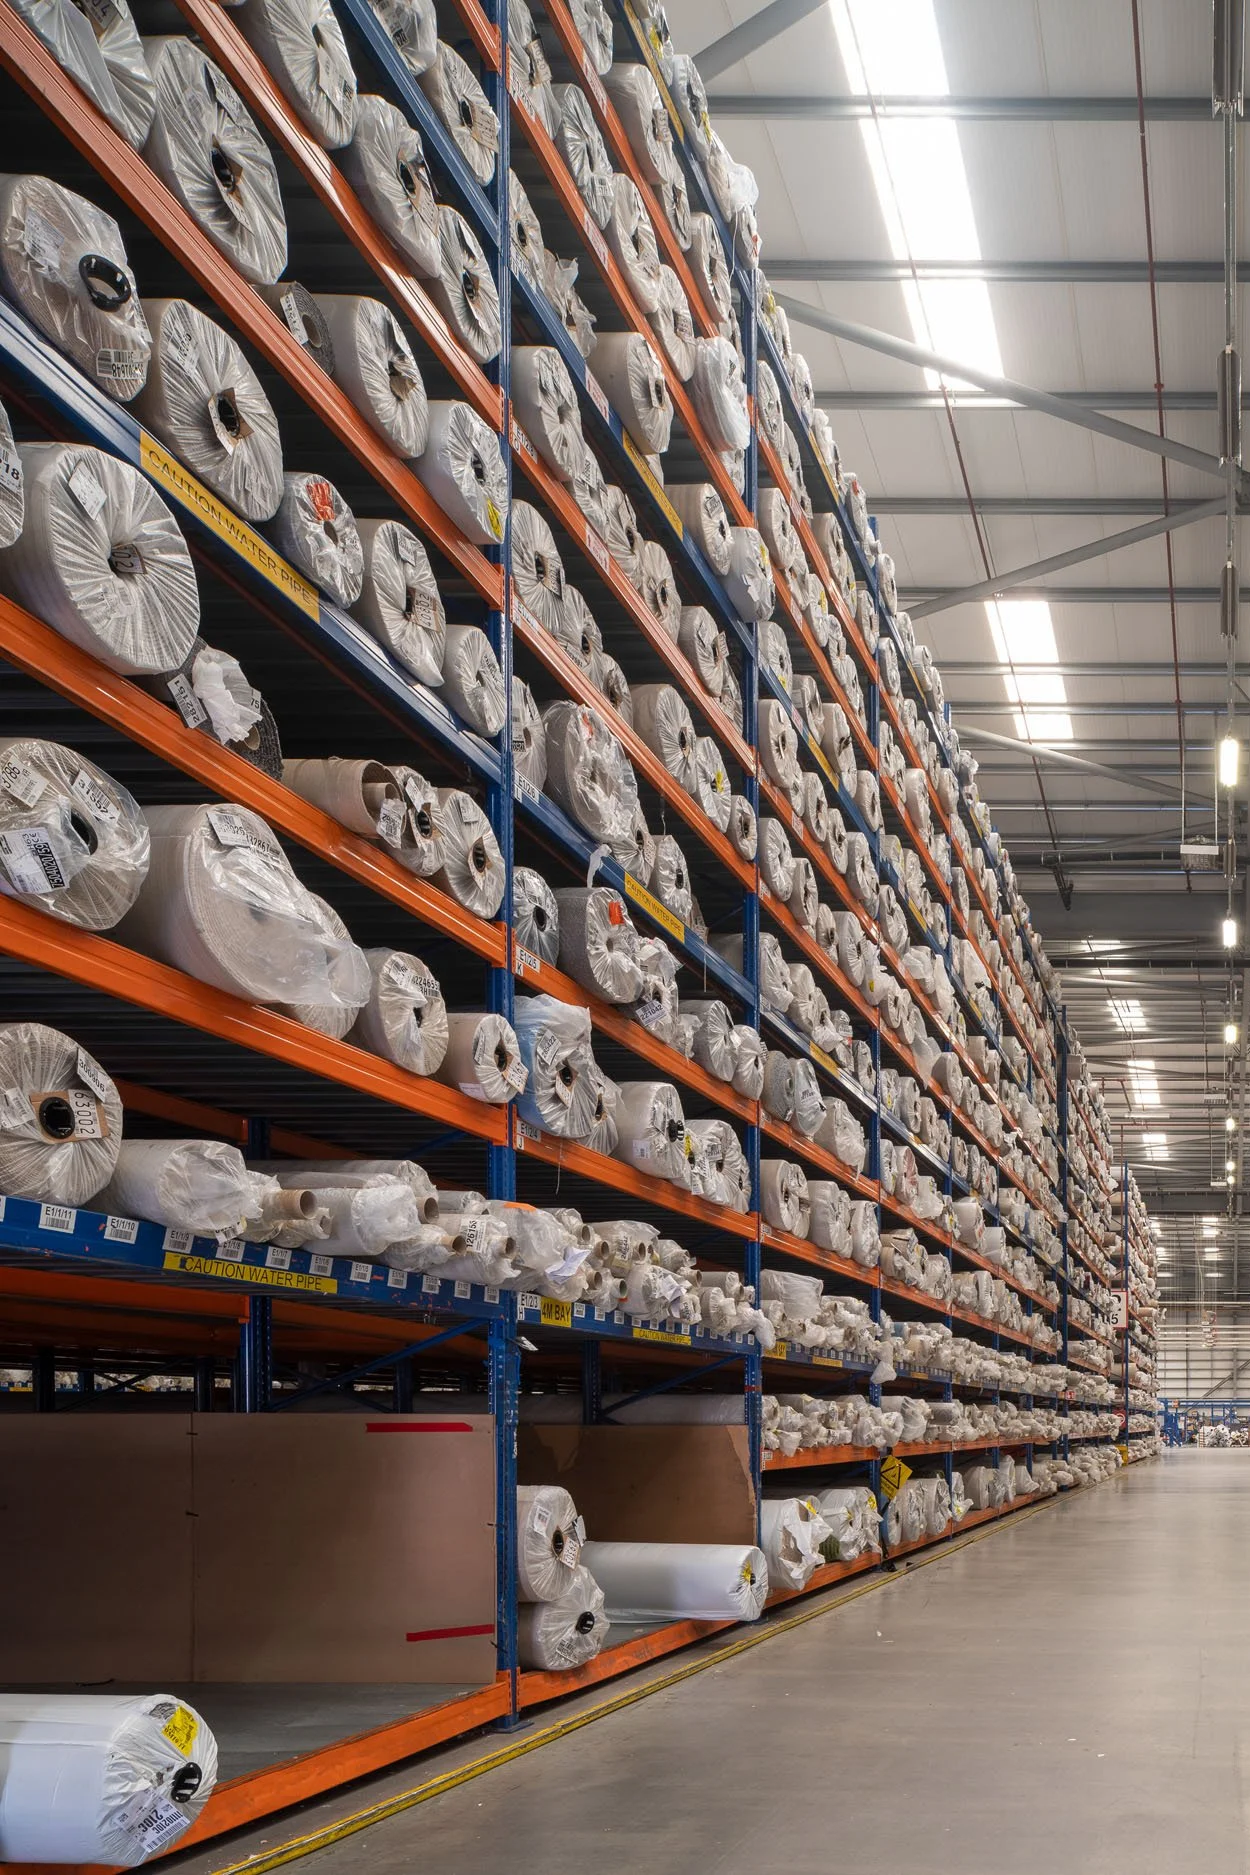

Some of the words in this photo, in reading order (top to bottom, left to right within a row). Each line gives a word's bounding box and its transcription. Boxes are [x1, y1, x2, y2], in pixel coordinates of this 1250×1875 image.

[148, 449, 221, 521] CAUTION
[226, 520, 279, 575] WATER
[279, 566, 314, 607] PIPE
[174, 679, 200, 723] 282151
[519, 948, 538, 969] E1/2/5
[516, 962, 523, 975] K
[73, 1091, 96, 1136] 63002
[519, 1123, 539, 1138] E1/2/4
[517, 1136, 524, 1148] J
[44, 1205, 73, 1220] E1/1/11
[110, 1217, 136, 1231] E1/1/10
[170, 1230, 190, 1241] E1/1/9
[184, 1255, 246, 1280] CAUTION
[250, 1266, 293, 1287] WATER
[296, 1274, 322, 1291] PIPE
[520, 1293, 539, 1308] E1/2/3
[518, 1307, 524, 1320] H
[555, 1304, 571, 1323] BAY
